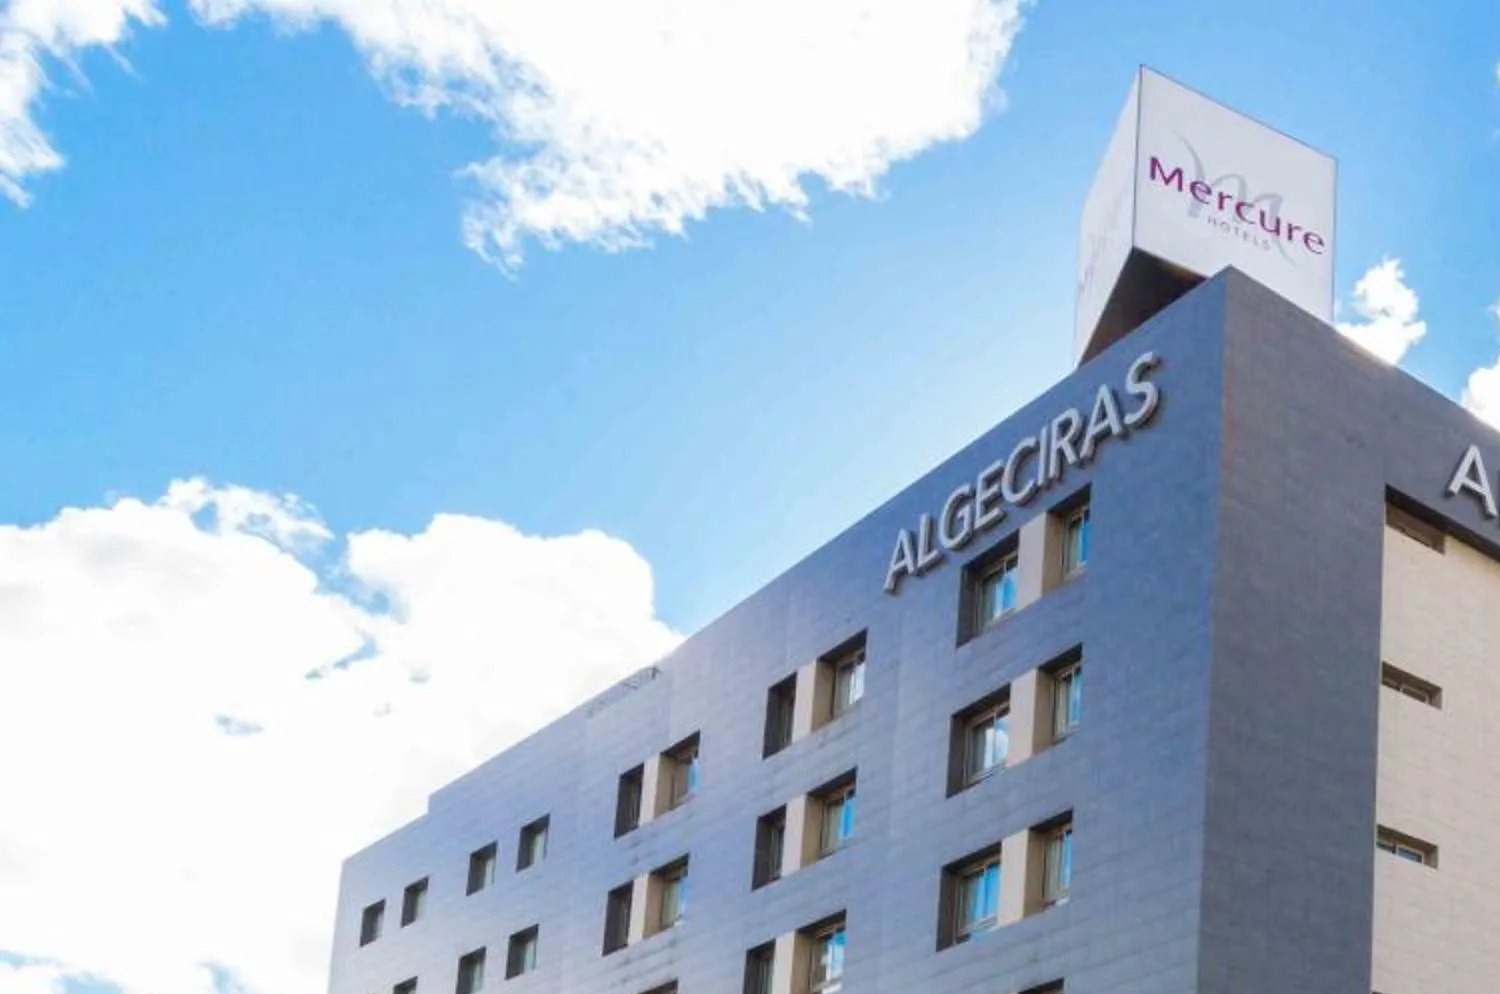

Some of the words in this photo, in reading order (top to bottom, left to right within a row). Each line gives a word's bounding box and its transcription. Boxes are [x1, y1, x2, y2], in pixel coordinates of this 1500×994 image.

[1149, 156, 1325, 256] Mercure
[1207, 215, 1271, 252] HOTELS
[883, 350, 1163, 595] ALGECIRAS
